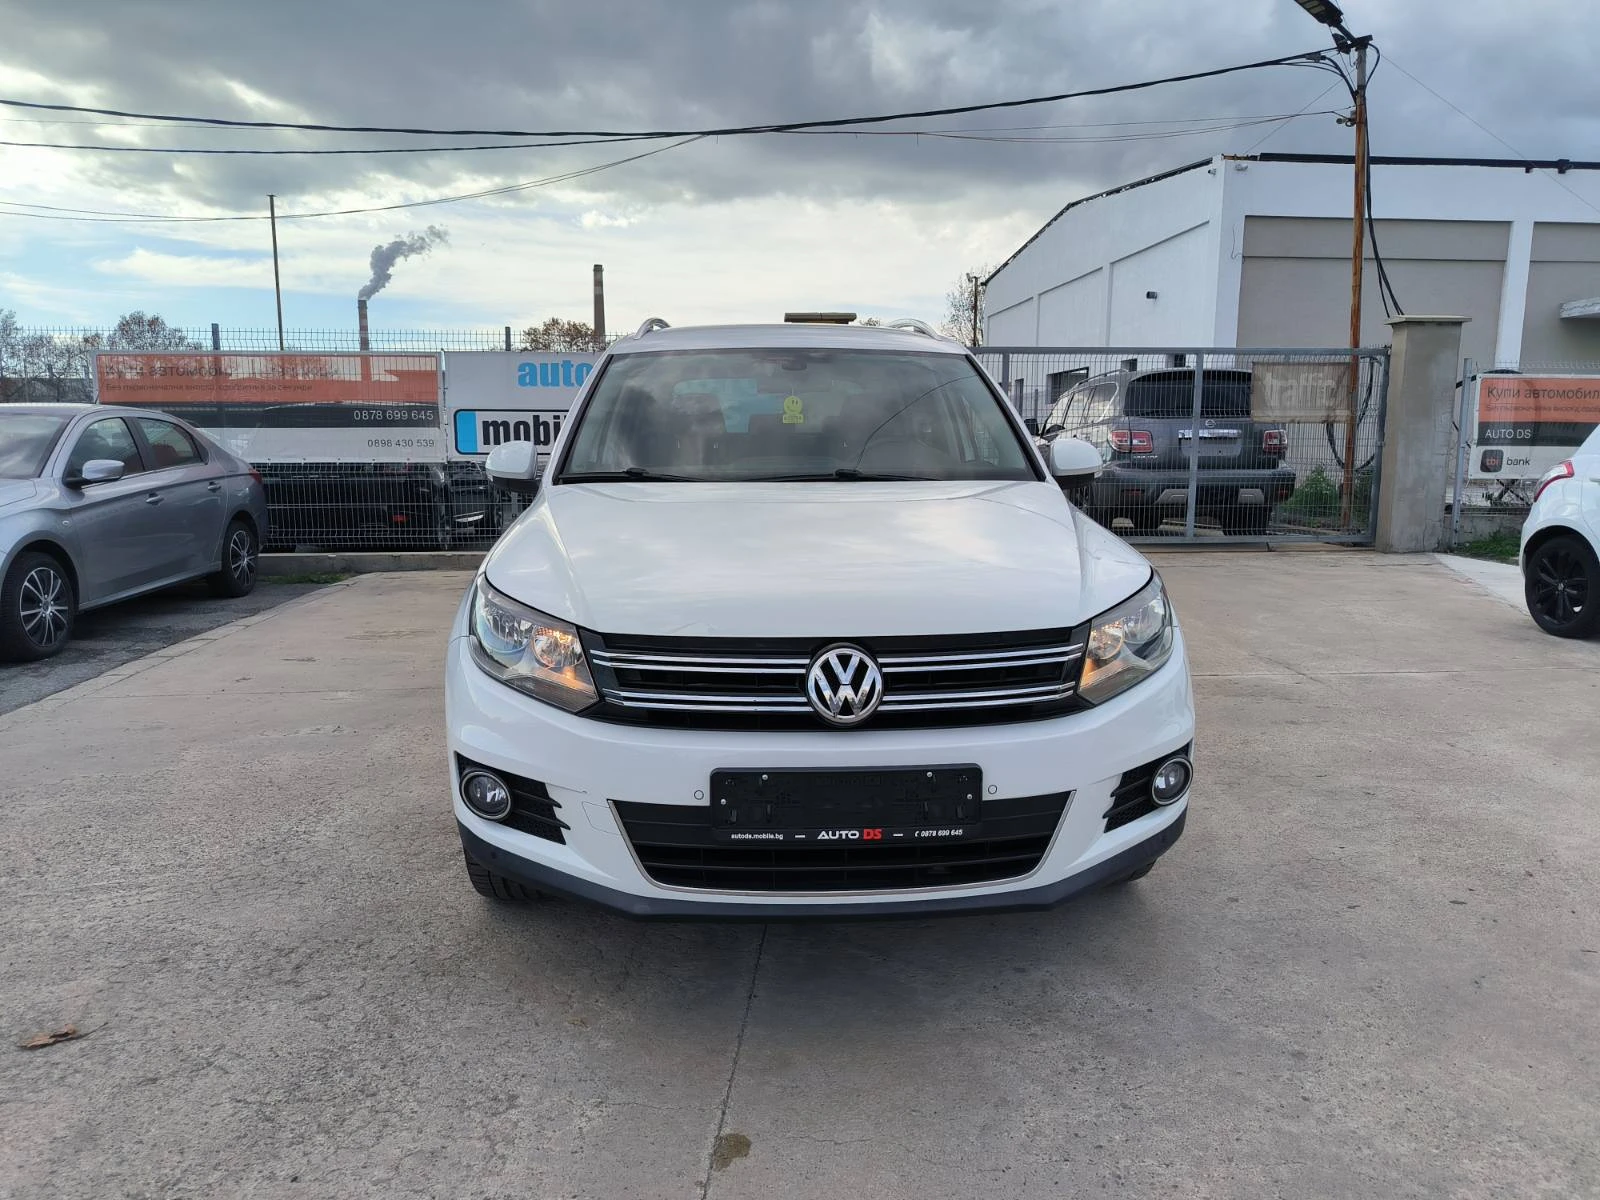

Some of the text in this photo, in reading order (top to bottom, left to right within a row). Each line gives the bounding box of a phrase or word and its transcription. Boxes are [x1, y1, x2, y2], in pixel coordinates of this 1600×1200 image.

[518, 360, 593, 387] auto
[1487, 386, 1520, 400] Купи
[354, 410, 434, 420] 0878 699 645
[482, 415, 567, 446] mobi
[1485, 429, 1532, 439] AUTO DS
[367, 439, 435, 447] 0898 430 539
[1506, 457, 1531, 466] bank
[817, 830, 860, 840] AUTO
[863, 829, 882, 840] DS
